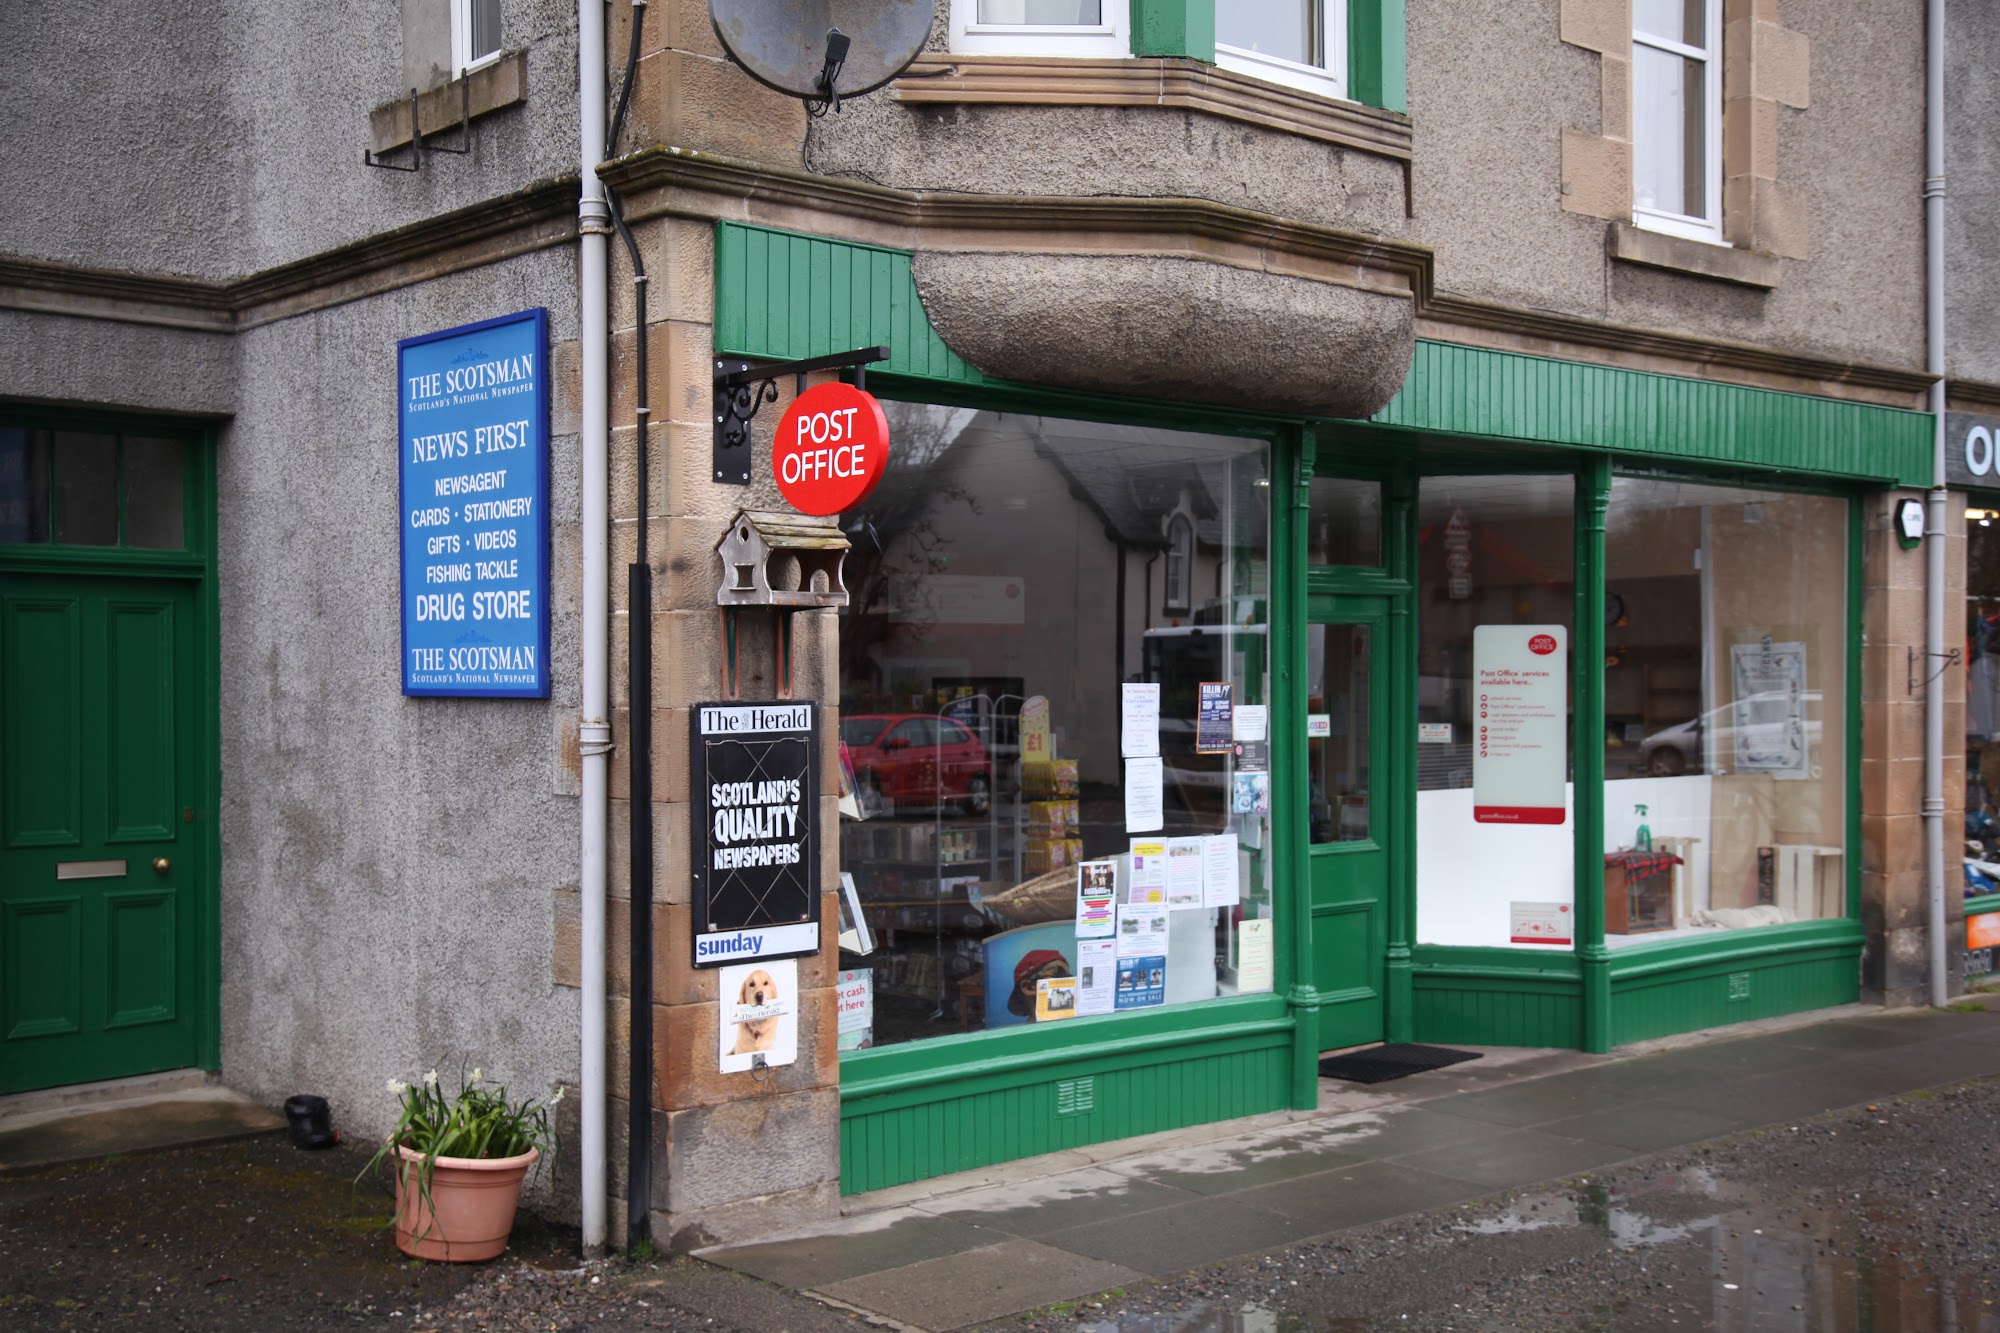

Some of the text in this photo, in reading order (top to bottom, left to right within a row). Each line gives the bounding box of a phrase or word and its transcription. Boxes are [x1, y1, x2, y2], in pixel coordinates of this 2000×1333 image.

[409, 353, 533, 400] THE SCOTSMAN
[409, 382, 533, 413] SCOTLAND'S NATIONAL NEWSPAPER
[797, 407, 858, 446] POST
[412, 420, 529, 464] NEWS FIRST
[781, 444, 865, 484] OFFICE
[435, 470, 507, 496] NEWSAGENT
[411, 497, 532, 528] CARDS STATIONERY
[427, 528, 517, 555] GIFTS VIDEOS
[426, 559, 518, 584] FISHING TACKLE
[416, 590, 531, 622] DRUG STORE
[412, 646, 535, 671] THE SCOTSMAN
[412, 672, 536, 684] SCOTLAND'S NATIONAL NEWSPAPER
[1480, 669, 1495, 677] Post
[704, 708, 808, 732] The Herald
[1307, 721, 1328, 729] OSED
[1027, 733, 1042, 752] £1
[711, 778, 800, 808] SCOTLAND'S
[714, 804, 799, 846] QUALITY
[714, 842, 800, 870] NEWSPAPERS
[698, 932, 763, 956] sunday
[846, 984, 865, 998] cash
[758, 1007, 780, 1017] Herald
[845, 1000, 865, 1011] here
